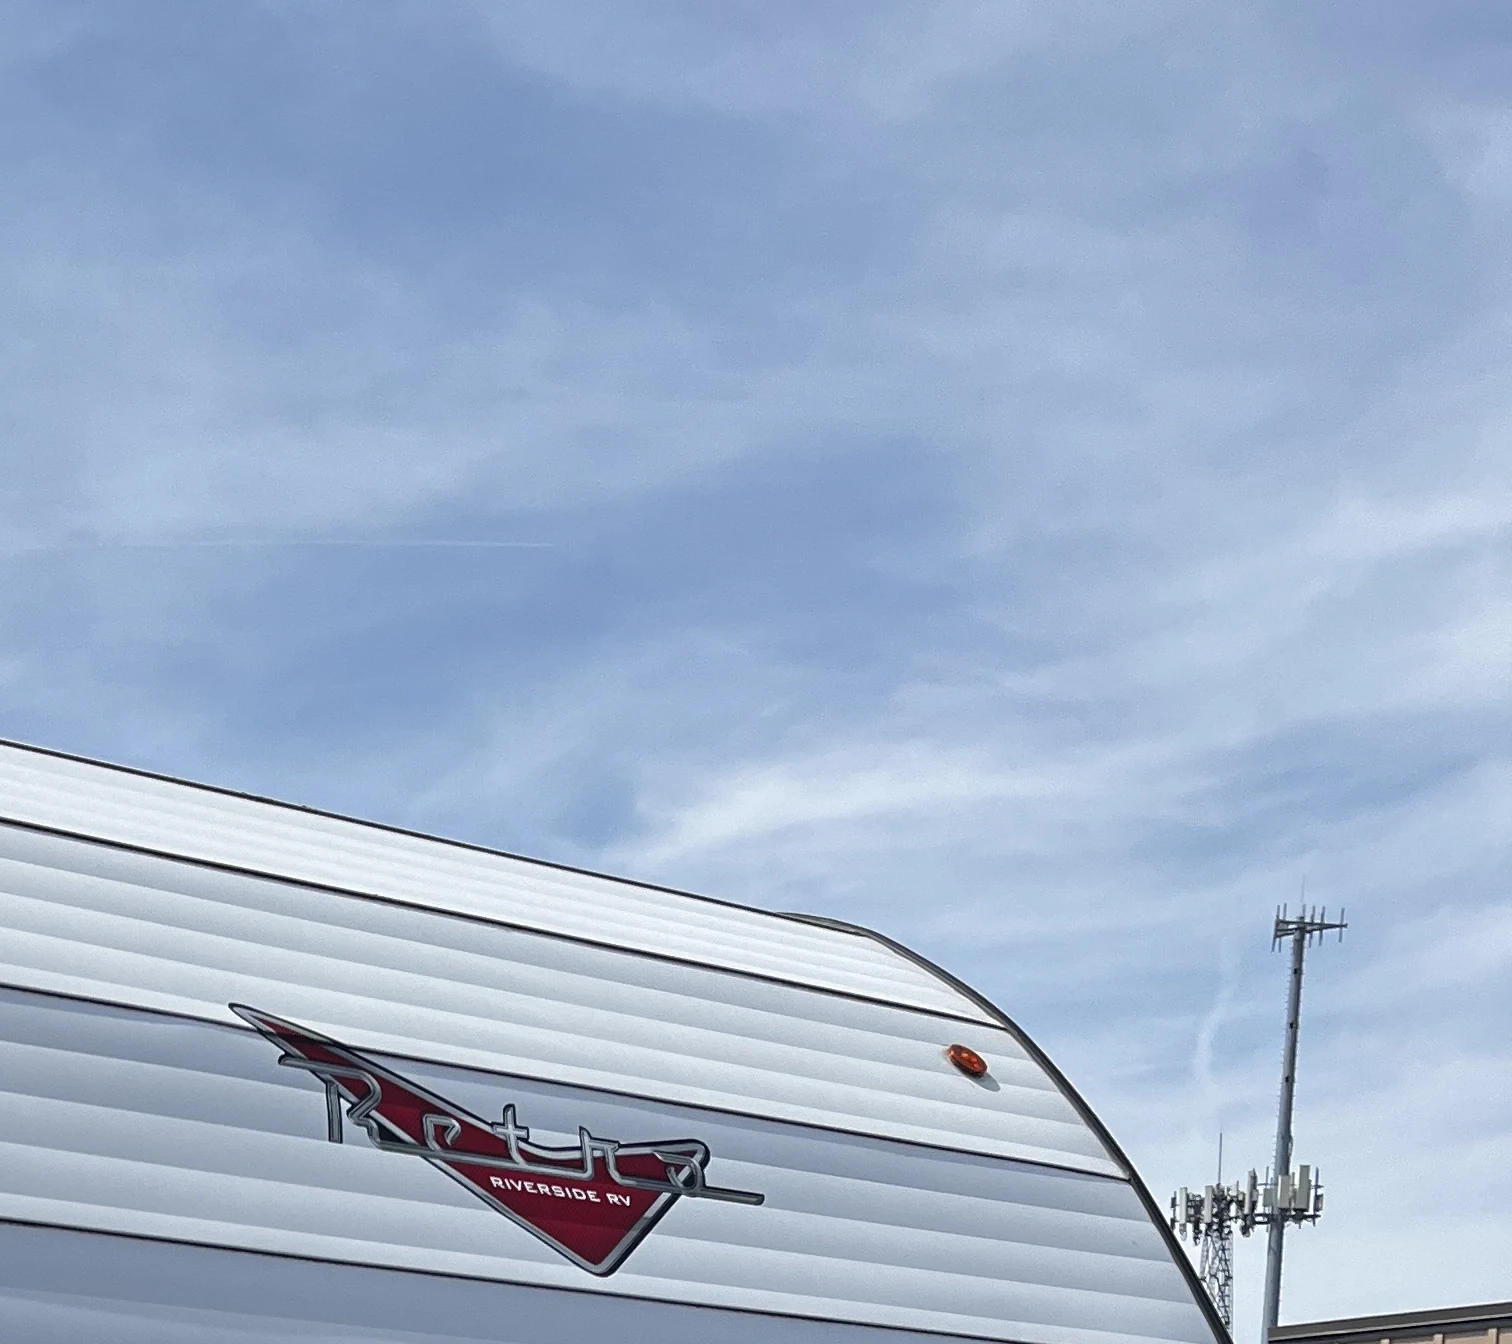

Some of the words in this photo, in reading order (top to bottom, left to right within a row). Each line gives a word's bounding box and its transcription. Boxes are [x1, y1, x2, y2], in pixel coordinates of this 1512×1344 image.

[278, 1053, 766, 1206] Retro
[489, 1176, 601, 1203] RIVERSIDE
[606, 1193, 632, 1207] RV
